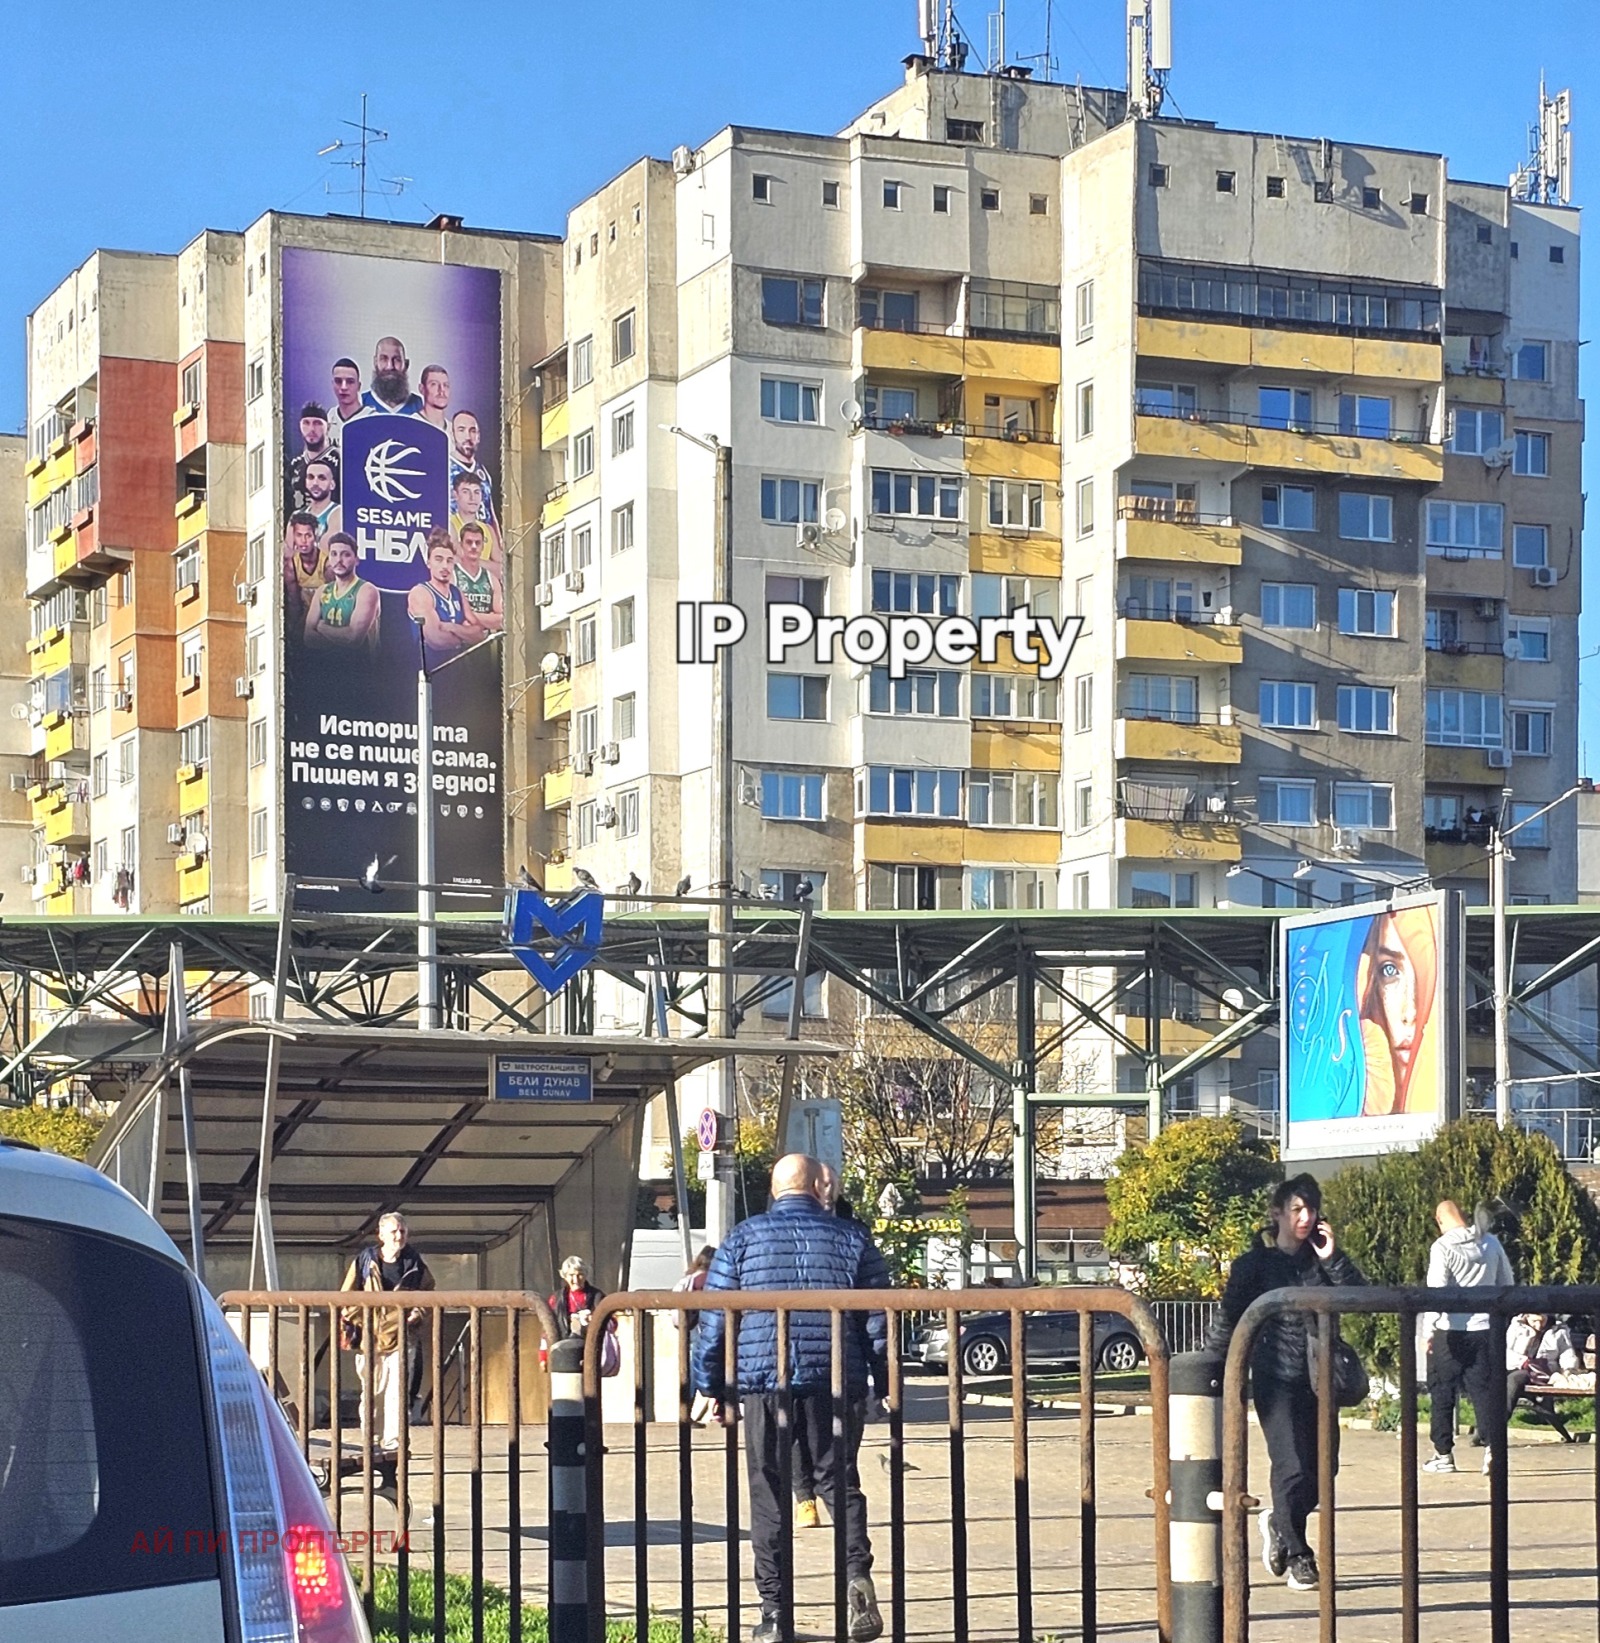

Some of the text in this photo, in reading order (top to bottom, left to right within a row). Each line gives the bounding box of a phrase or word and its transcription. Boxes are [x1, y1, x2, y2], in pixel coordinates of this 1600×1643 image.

[356, 507, 432, 529] SESAME
[320, 715, 468, 743] Историта
[290, 741, 319, 758] не
[325, 744, 353, 760] се
[431, 749, 497, 769] сама.
[292, 762, 496, 796] Пишем я зедно!
[508, 1076, 581, 1087] БЕЛИ ДУНАВ
[518, 1088, 571, 1097] BELI DUNAV
